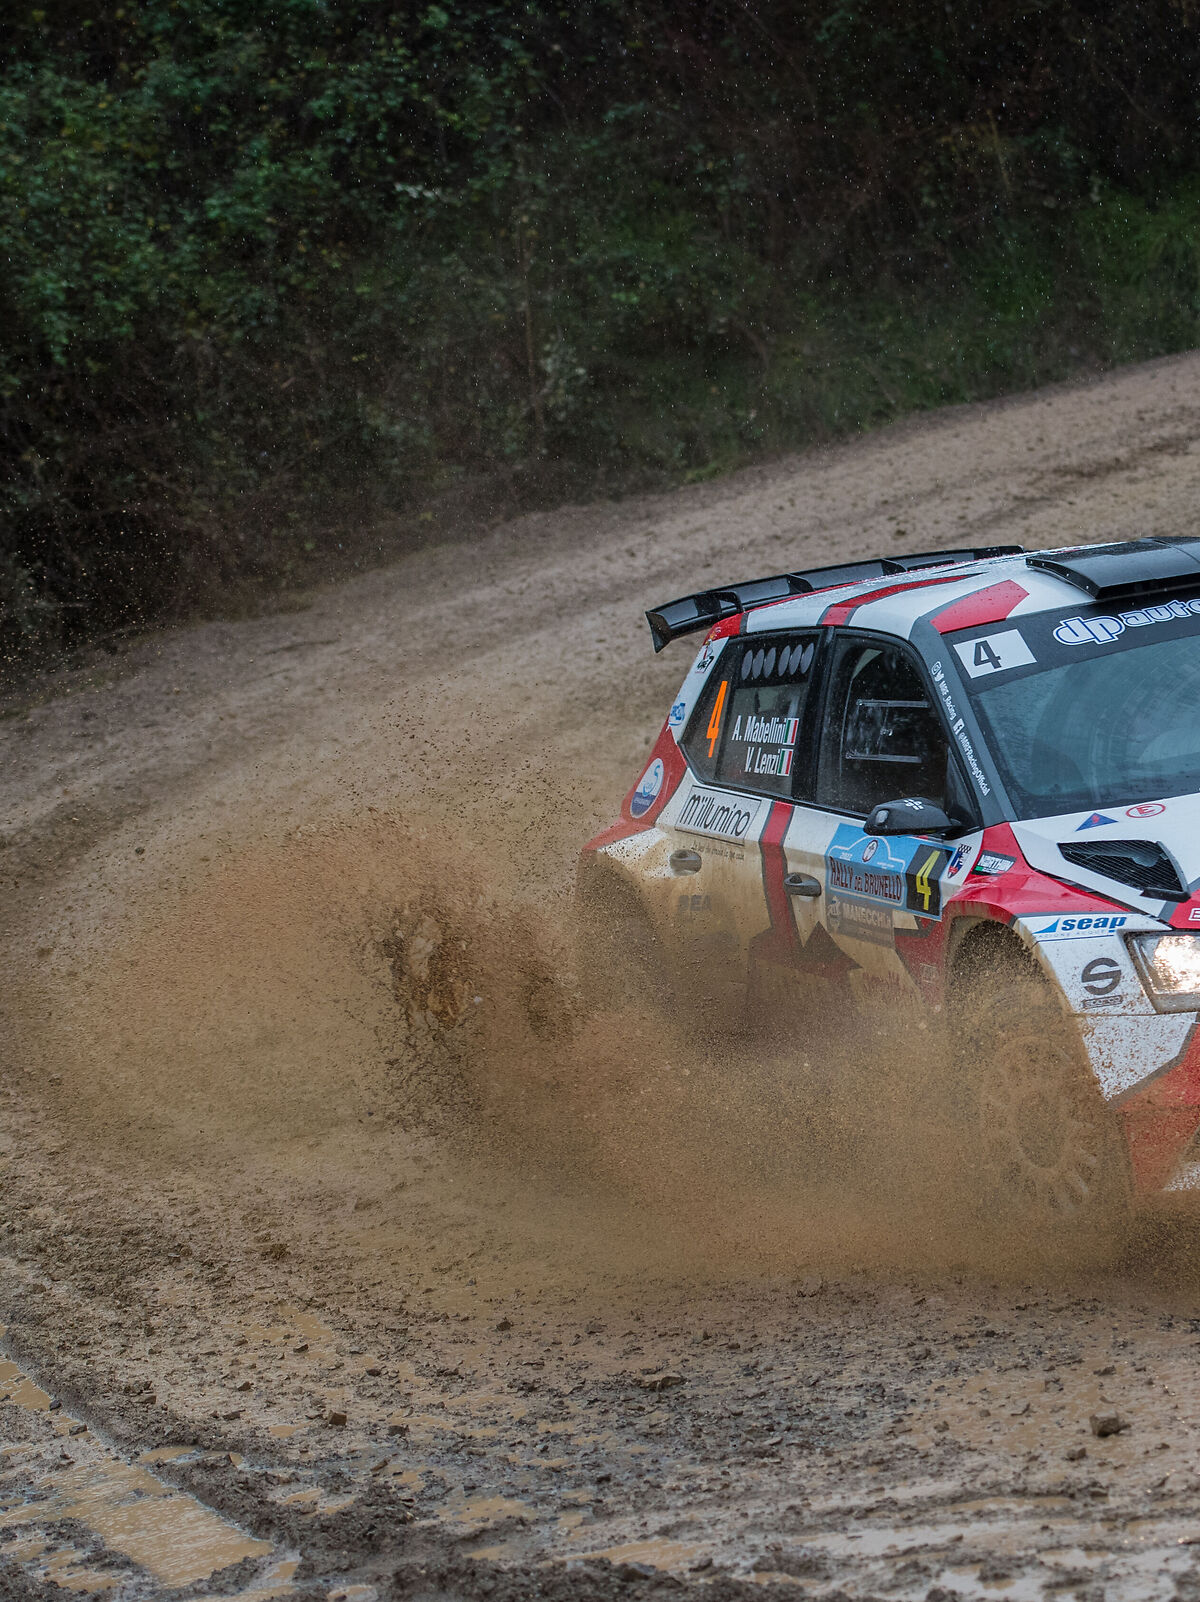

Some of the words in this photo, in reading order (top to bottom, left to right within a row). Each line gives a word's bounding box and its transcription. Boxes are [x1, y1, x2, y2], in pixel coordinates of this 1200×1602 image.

[1052, 616, 1126, 645] dp
[973, 639, 1002, 670] 4
[706, 680, 728, 758] 4
[731, 714, 742, 741] A.
[743, 715, 786, 745] Mabellini
[744, 747, 752, 773] V.
[753, 748, 780, 776] Lenzi
[829, 856, 854, 888] RALLY
[864, 873, 902, 901] BRUNELLO
[916, 850, 941, 911] 4
[1061, 916, 1127, 934] seap
